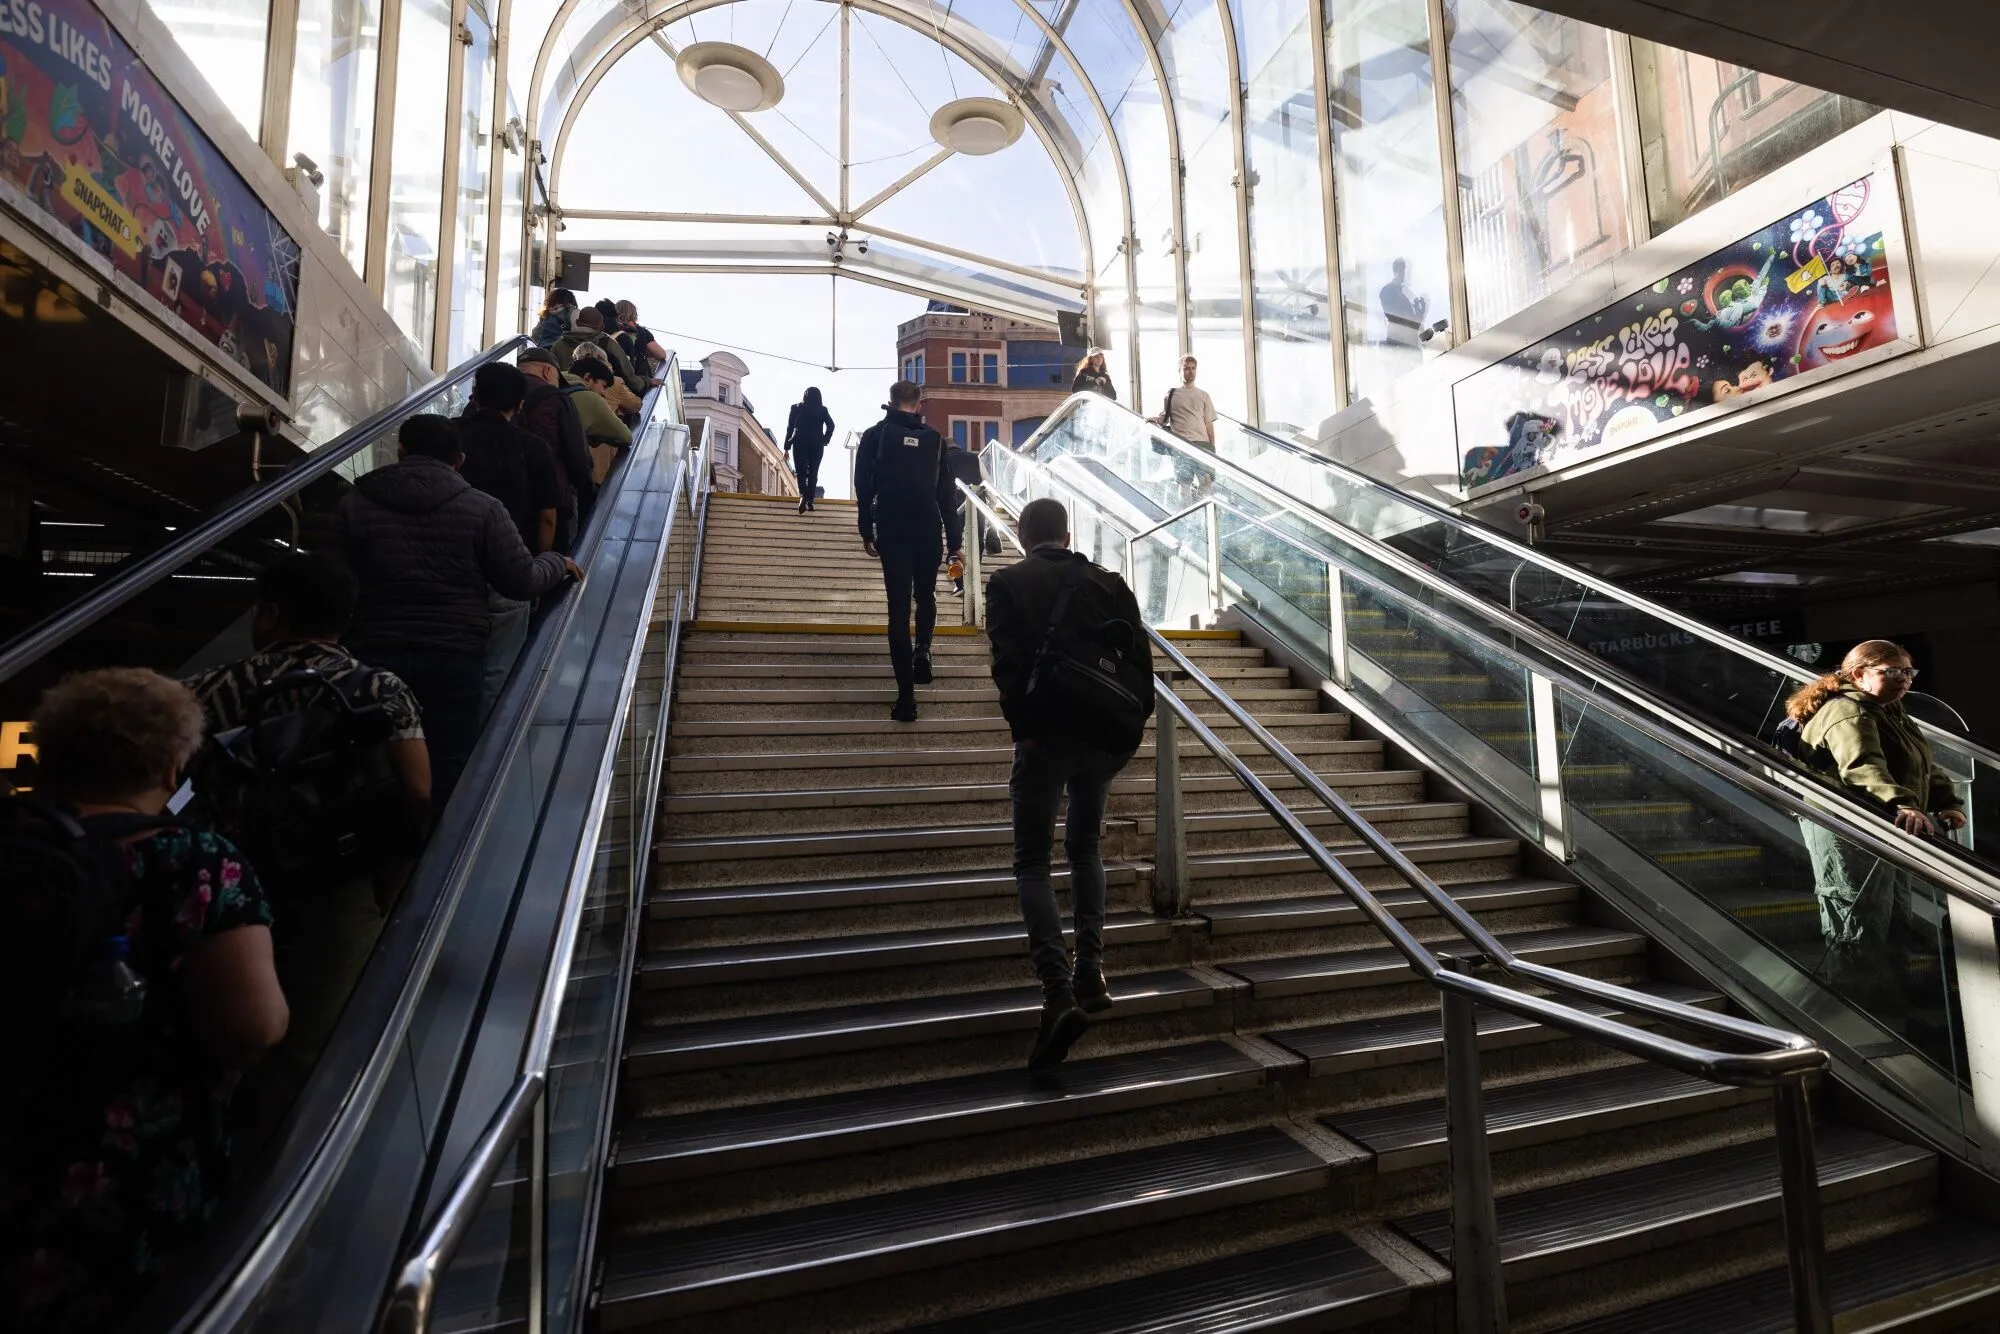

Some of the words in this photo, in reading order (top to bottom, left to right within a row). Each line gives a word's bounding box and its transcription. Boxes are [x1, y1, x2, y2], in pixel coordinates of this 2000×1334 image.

[0, 0, 44, 43] ESS
[49, 12, 111, 91] LIKES
[121, 79, 175, 170] MORE
[172, 158, 210, 235] LOVE
[73, 178, 124, 234] SNAPCHAT
[1588, 631, 1695, 653] STARBUCKS
